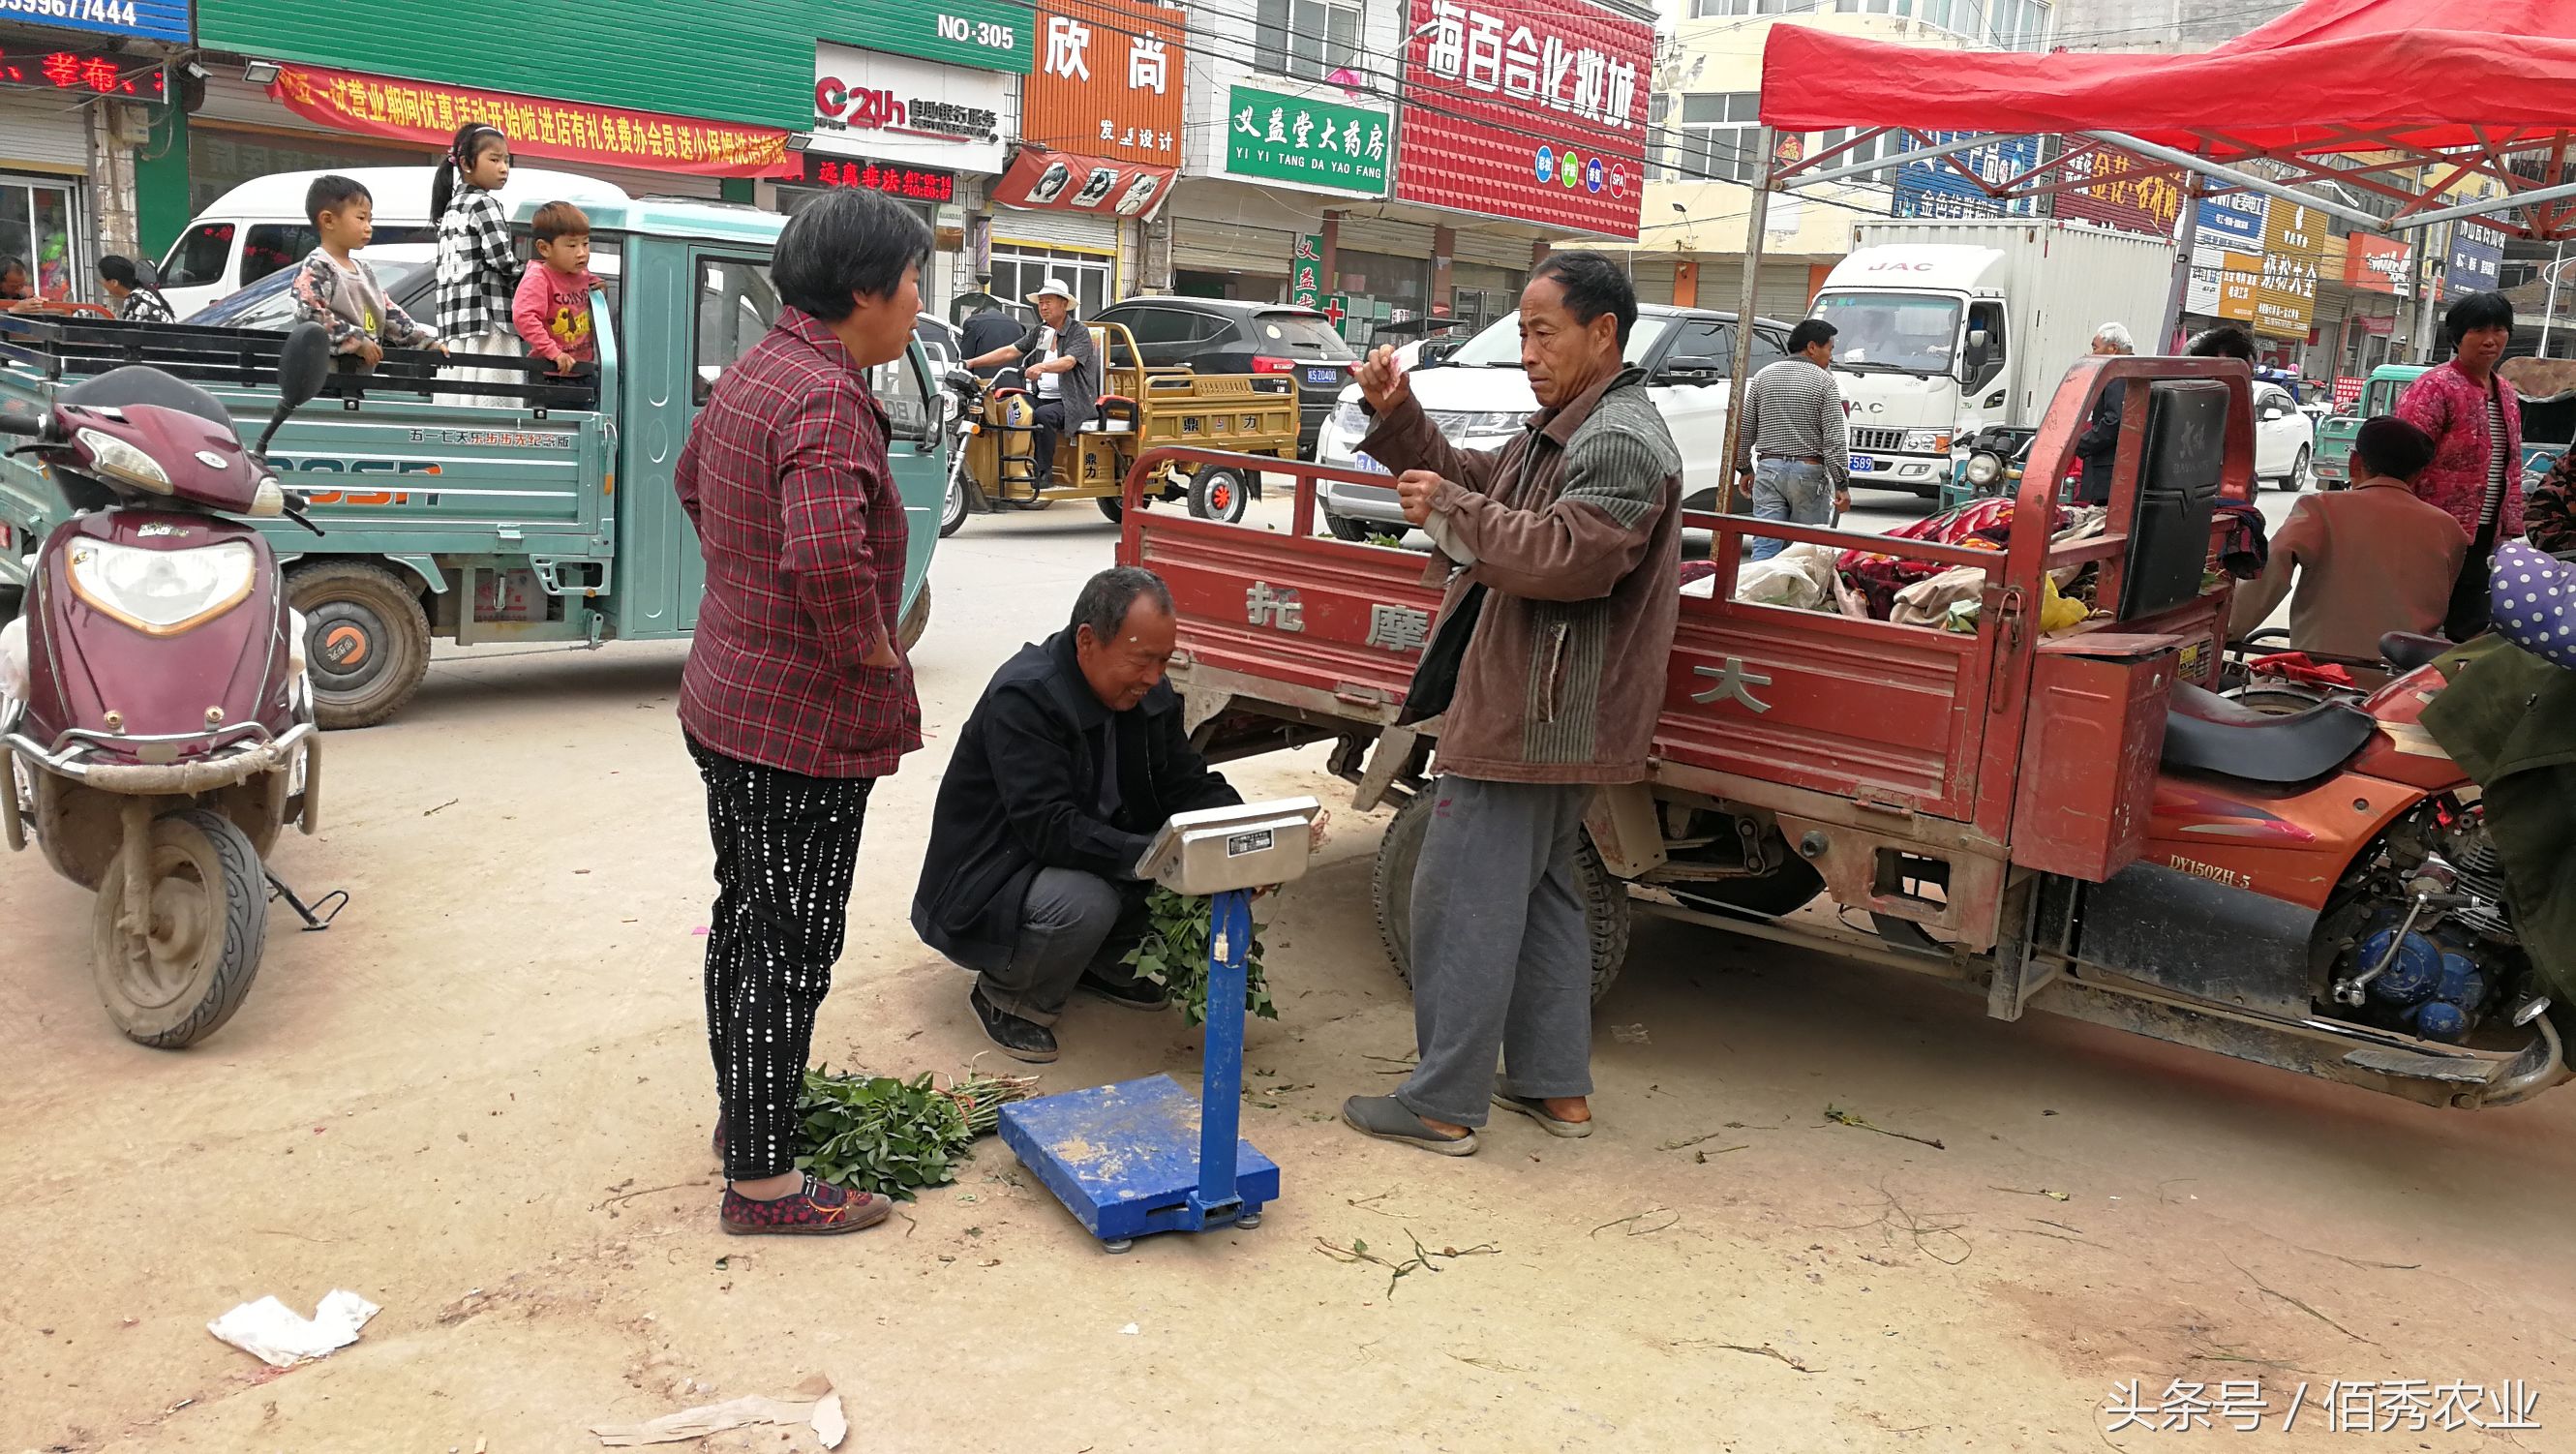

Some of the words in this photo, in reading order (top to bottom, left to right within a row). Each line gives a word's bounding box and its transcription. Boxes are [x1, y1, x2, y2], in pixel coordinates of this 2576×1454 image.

[1428, 0, 1635, 130] 海百合化妆城
[848, 86, 906, 131] 24h
[908, 98, 998, 128] 自助银行服务
[1236, 147, 1249, 159] YI
[1258, 150, 1269, 162] YI
[1278, 153, 1305, 167] TANG
[1312, 158, 1324, 170] DA
[1331, 161, 1350, 174] YAO
[1356, 166, 1381, 179] FANG
[1612, 172, 1623, 187] SPA
[1867, 262, 1935, 272] JAC
[2260, 251, 2318, 298] 奶粉大全
[1243, 415, 1257, 429] 力
[1850, 401, 1885, 413] AC
[1850, 456, 1872, 470] F589
[1690, 657, 1773, 713] 大
